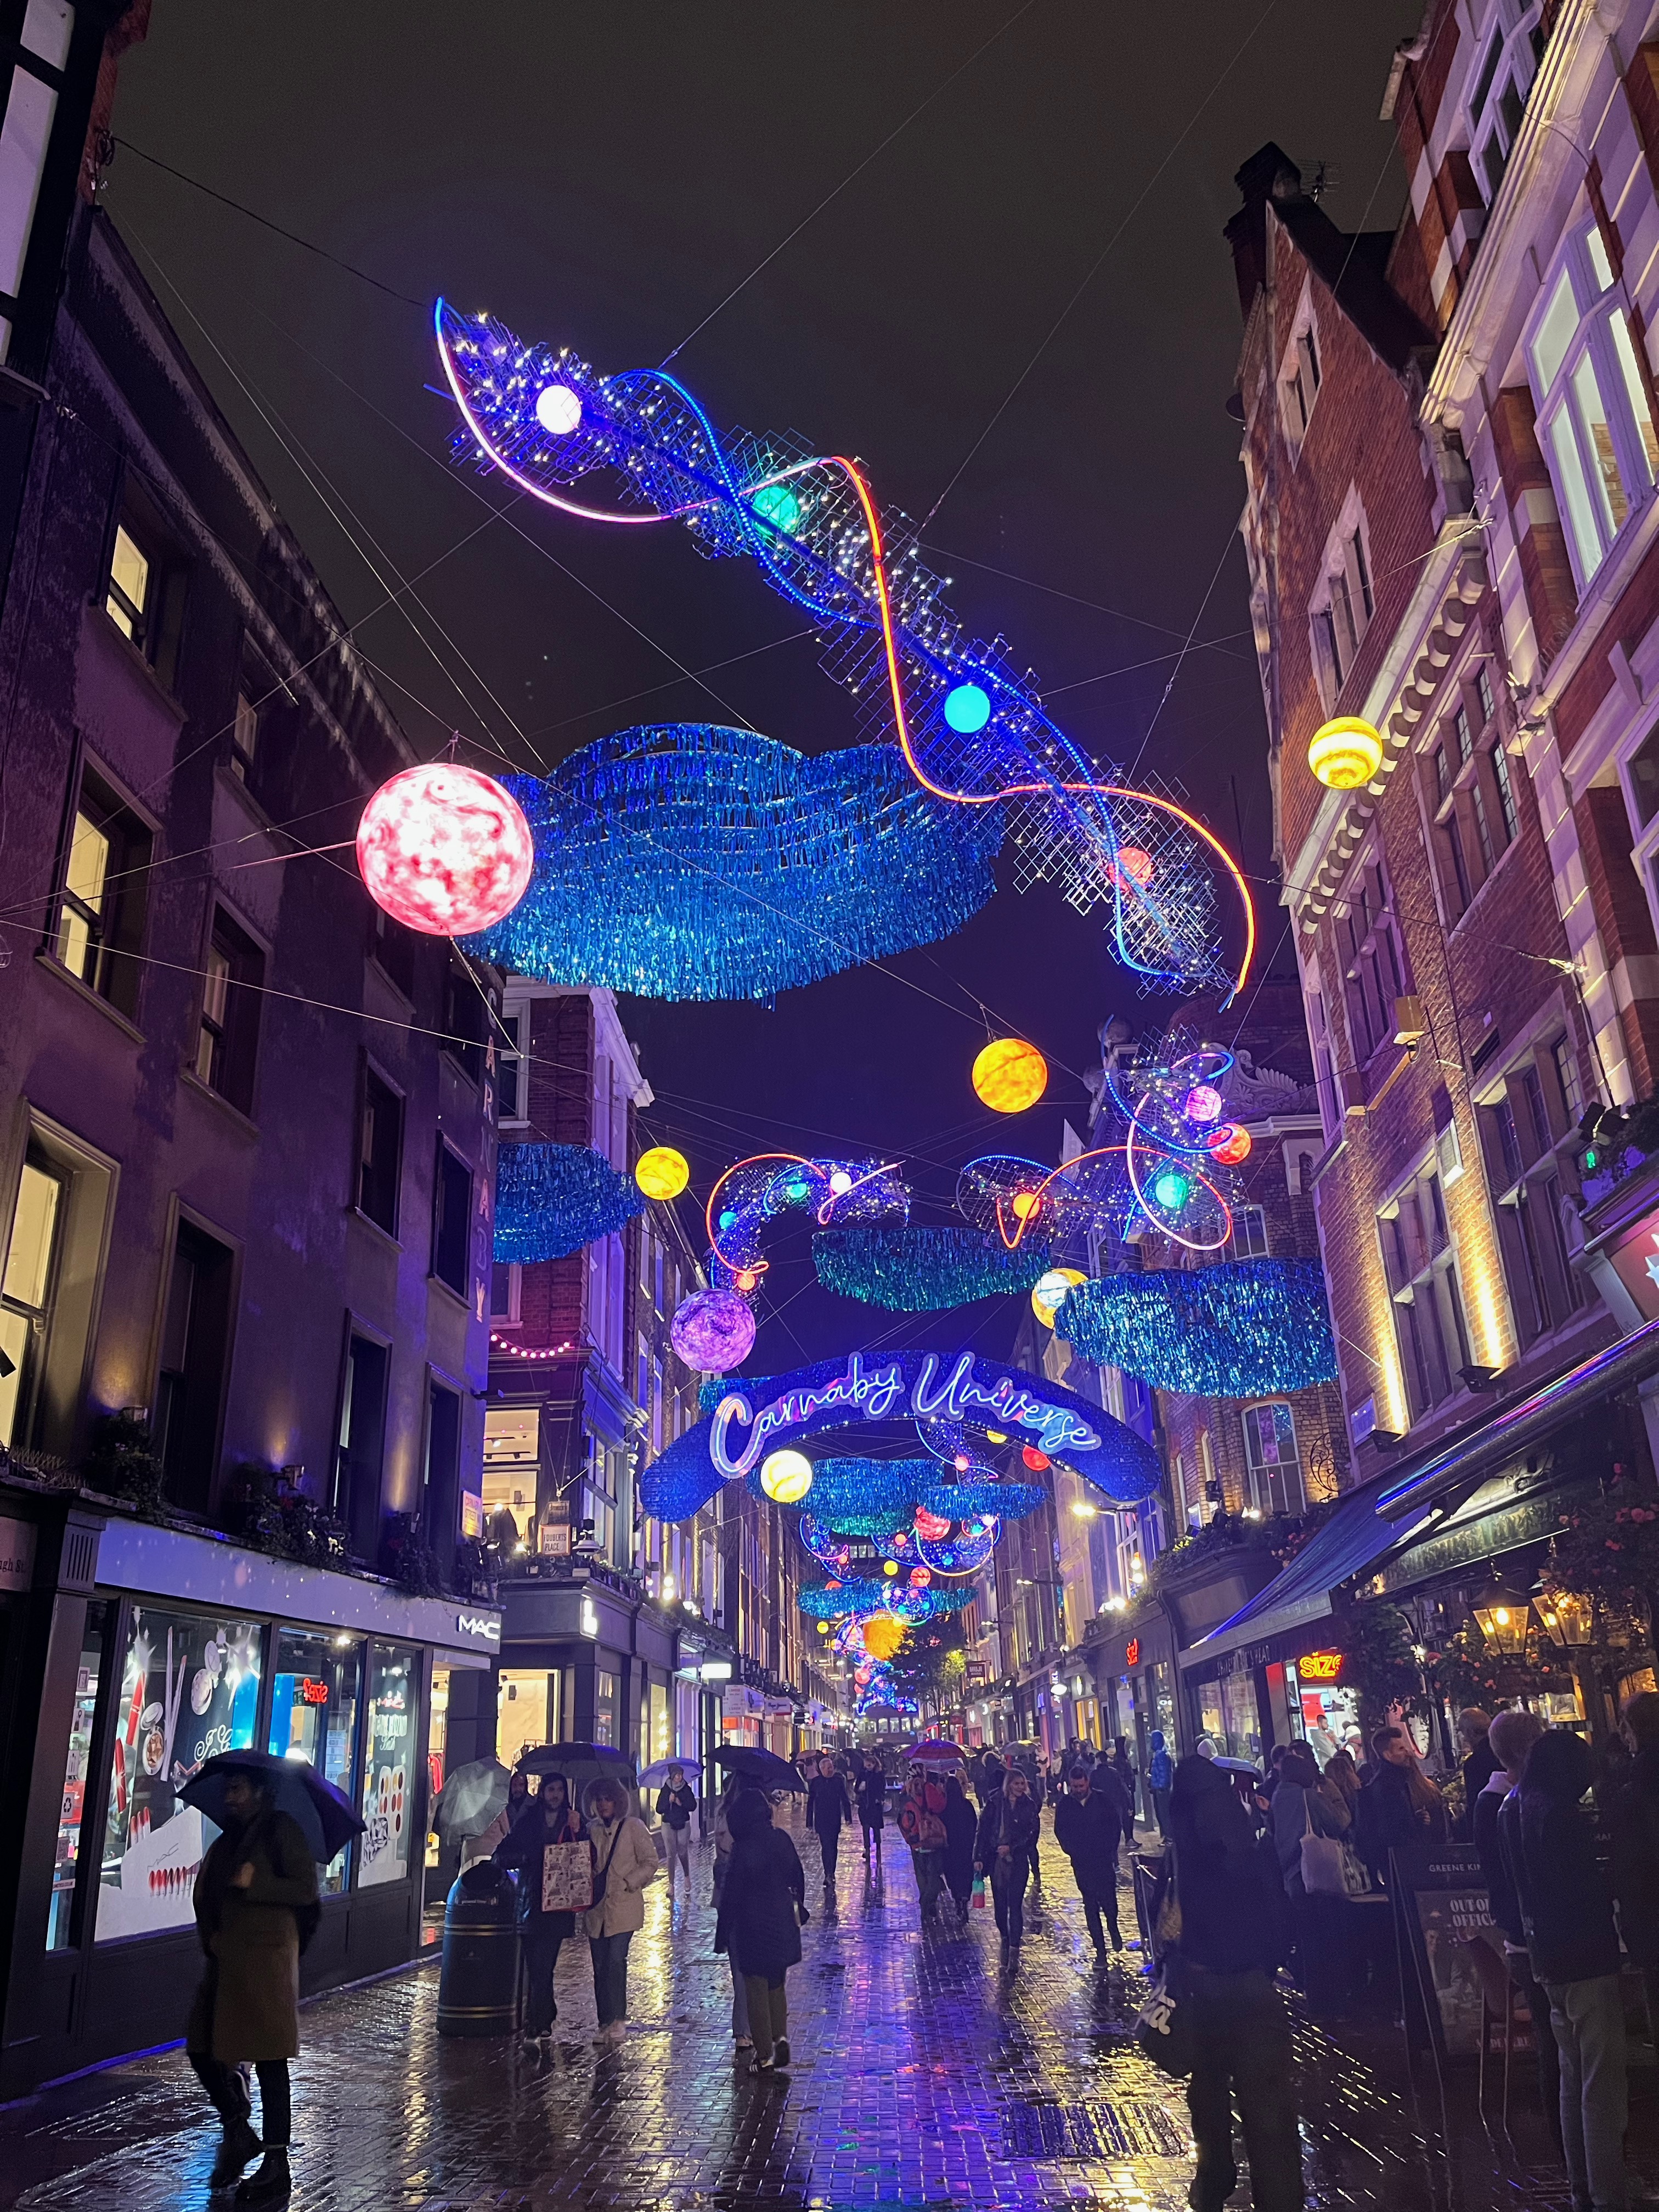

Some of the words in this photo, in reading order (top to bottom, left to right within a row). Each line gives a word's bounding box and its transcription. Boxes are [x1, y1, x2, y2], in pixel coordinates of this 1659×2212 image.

[715, 1355, 900, 1473] Carnaby
[915, 1356, 1097, 1448] Universe
[545, 1543, 560, 1551] PLACE
[458, 1615, 500, 1640] MAC
[1429, 1864, 1465, 1872] GREENE
[1449, 1898, 1475, 1913] OUT
